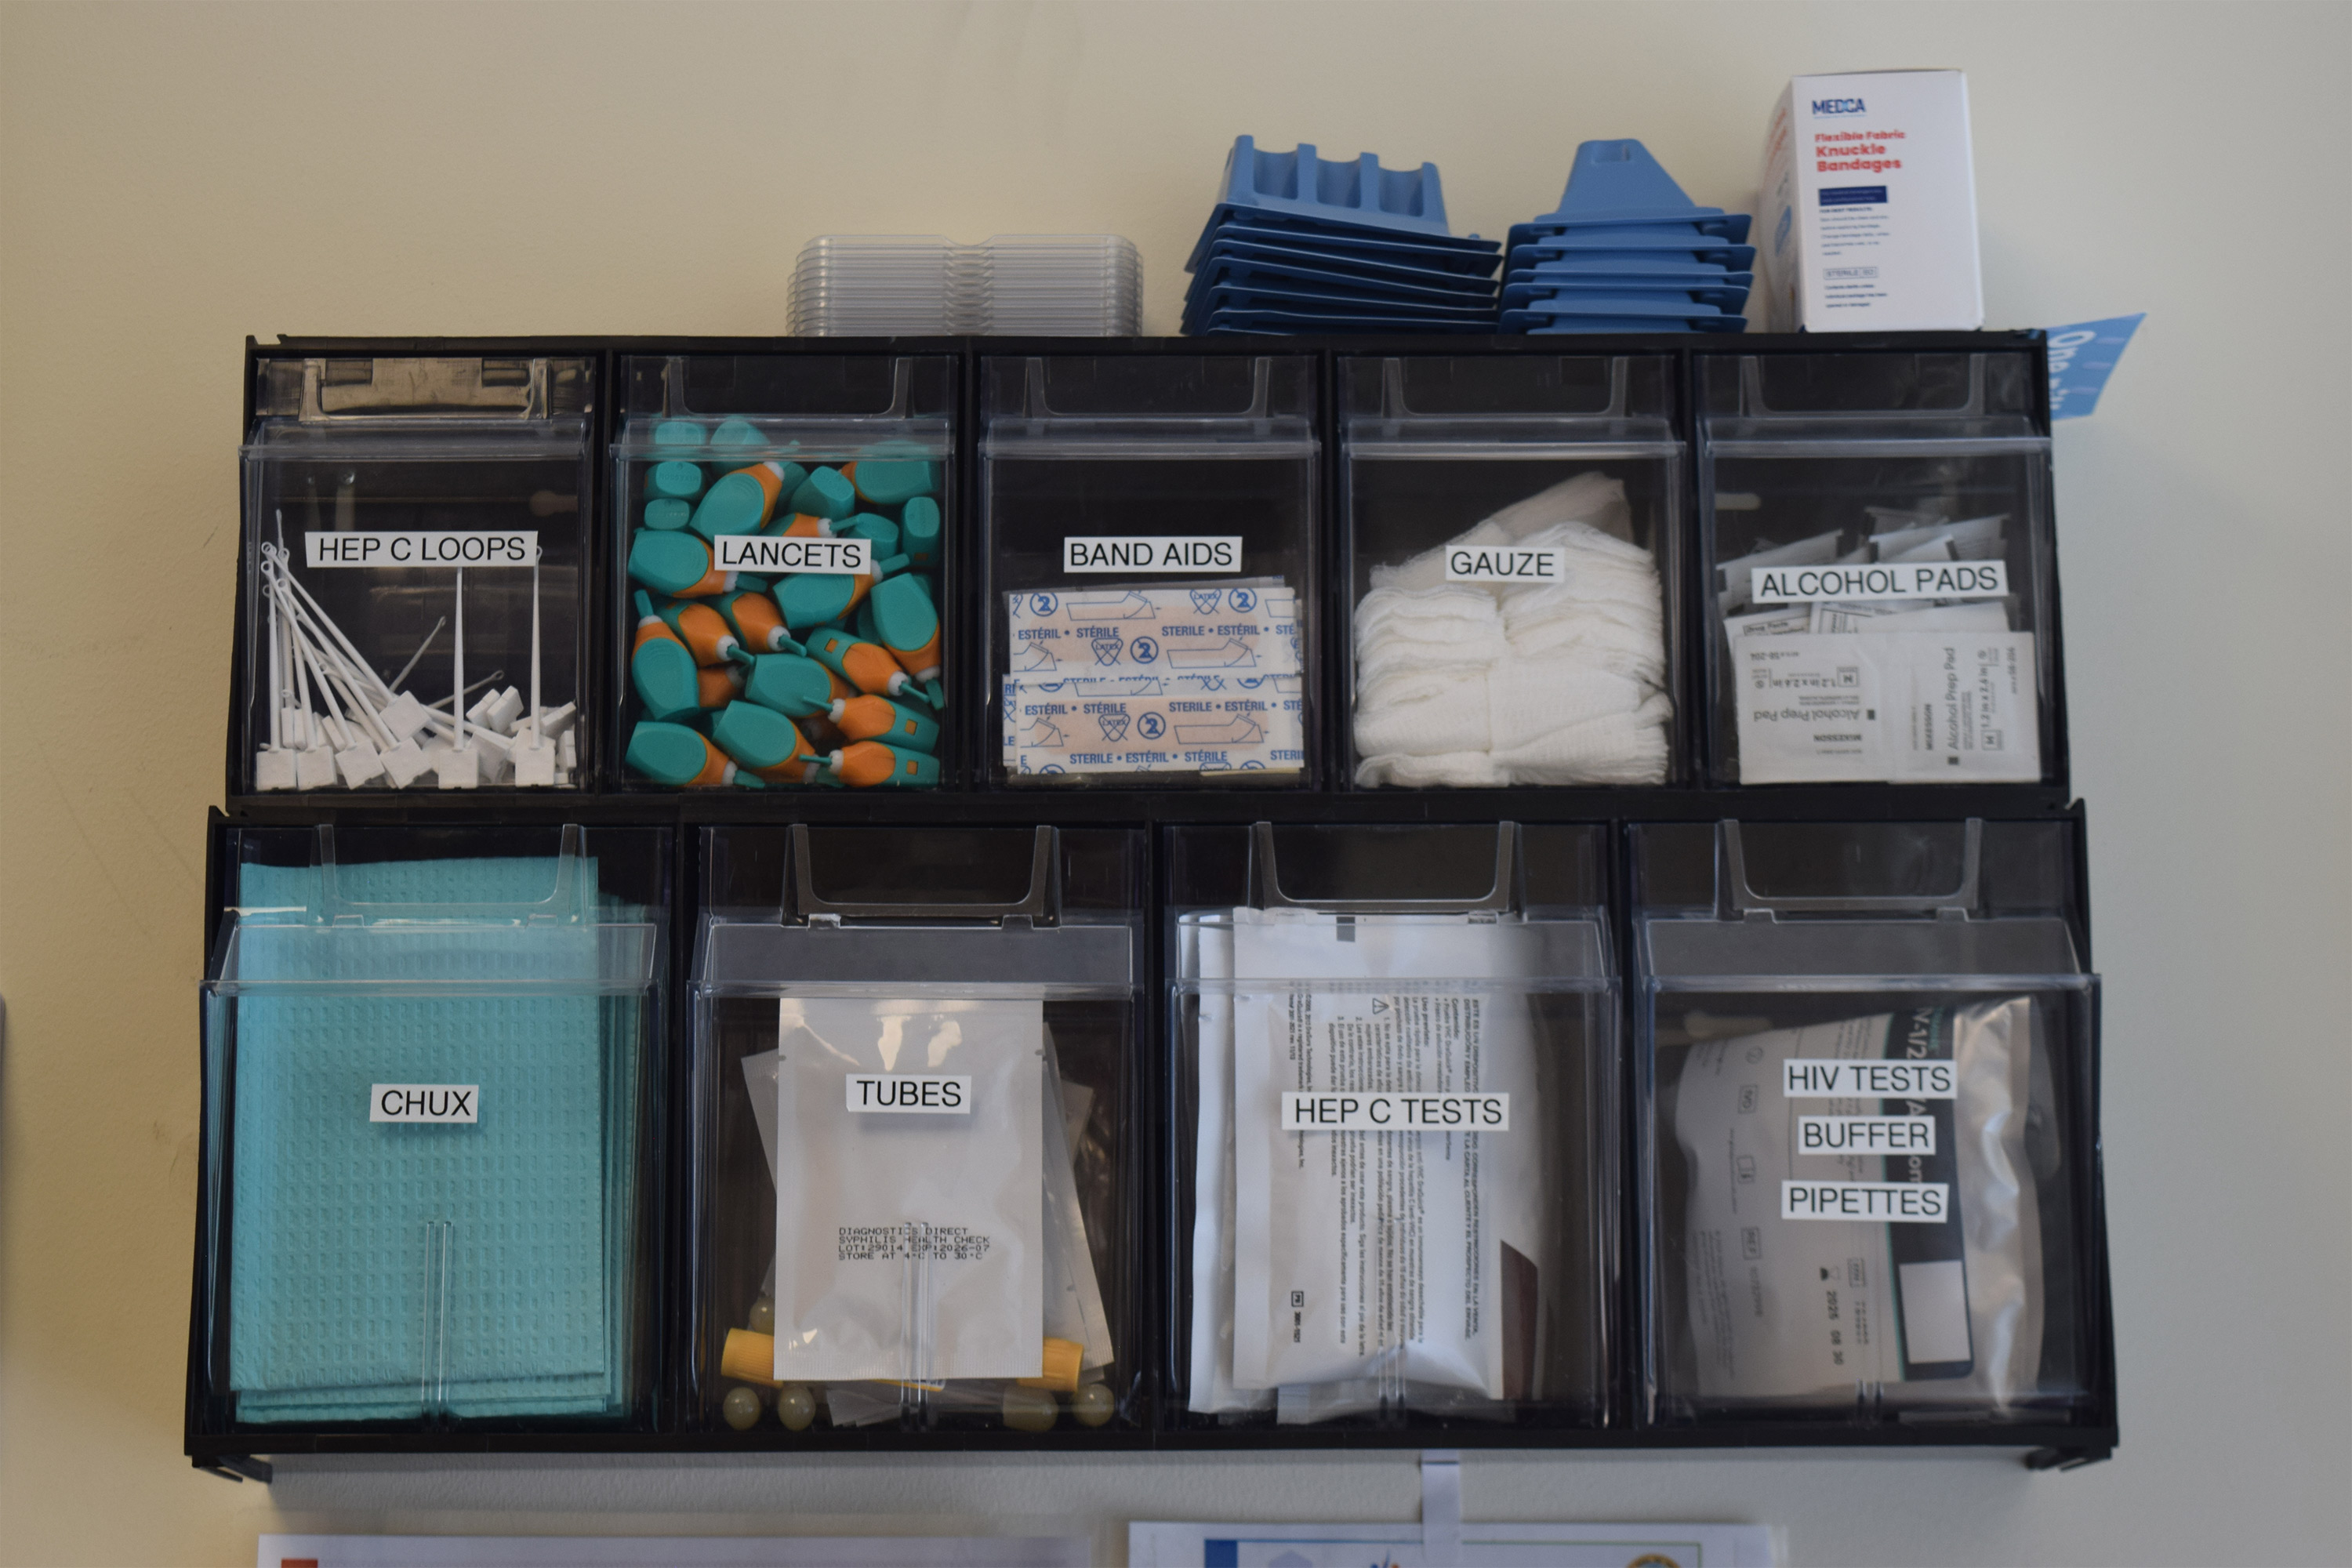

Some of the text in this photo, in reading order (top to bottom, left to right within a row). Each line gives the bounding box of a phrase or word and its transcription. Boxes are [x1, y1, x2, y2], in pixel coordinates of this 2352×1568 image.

[1814, 129, 1905, 142] Flexible Fabric
[1816, 143, 1886, 157] Knuckle
[1817, 158, 1901, 173] Bandages
[318, 536, 526, 561] HEP C LOOPS
[721, 541, 862, 568] LANCETS
[1070, 542, 1232, 567] BAND AIDS
[1450, 551, 1555, 577] GAUZE
[1760, 566, 1998, 597] ALCOHOL PADS
[1018, 627, 1061, 640] ESTÉRIL
[1076, 626, 1119, 638] STÉRILE
[1162, 626, 1204, 637] STERILE
[1218, 623, 1260, 636] ESTÉRIL
[1025, 702, 1068, 715] ESTÉRIL
[1083, 702, 1126, 714] STÉRILE
[1169, 702, 1212, 712] STERILE
[1225, 699, 1268, 712] ESTÉRIL
[1943, 648, 1958, 750] Alcohol Prep Pad
[1754, 708, 1860, 722] Alcohol Prep Pad
[1069, 753, 1113, 764] STERILE
[1126, 750, 1169, 763] ESTÉRIL
[1185, 750, 1227, 762] STÉRILE
[1473, 1020, 1479, 1029] ES
[1473, 1032, 1479, 1044] UN
[1788, 1065, 1951, 1094] HIV TESTS
[381, 1090, 471, 1116] CHUX
[856, 1080, 963, 1108] TUBES
[1295, 1098, 1503, 1126] HEP C TESTS
[1804, 1123, 1929, 1149] BUFFER
[1788, 1188, 1942, 1217] PIPETTES
[839, 1227, 918, 1236] DIAGNOSTICS
